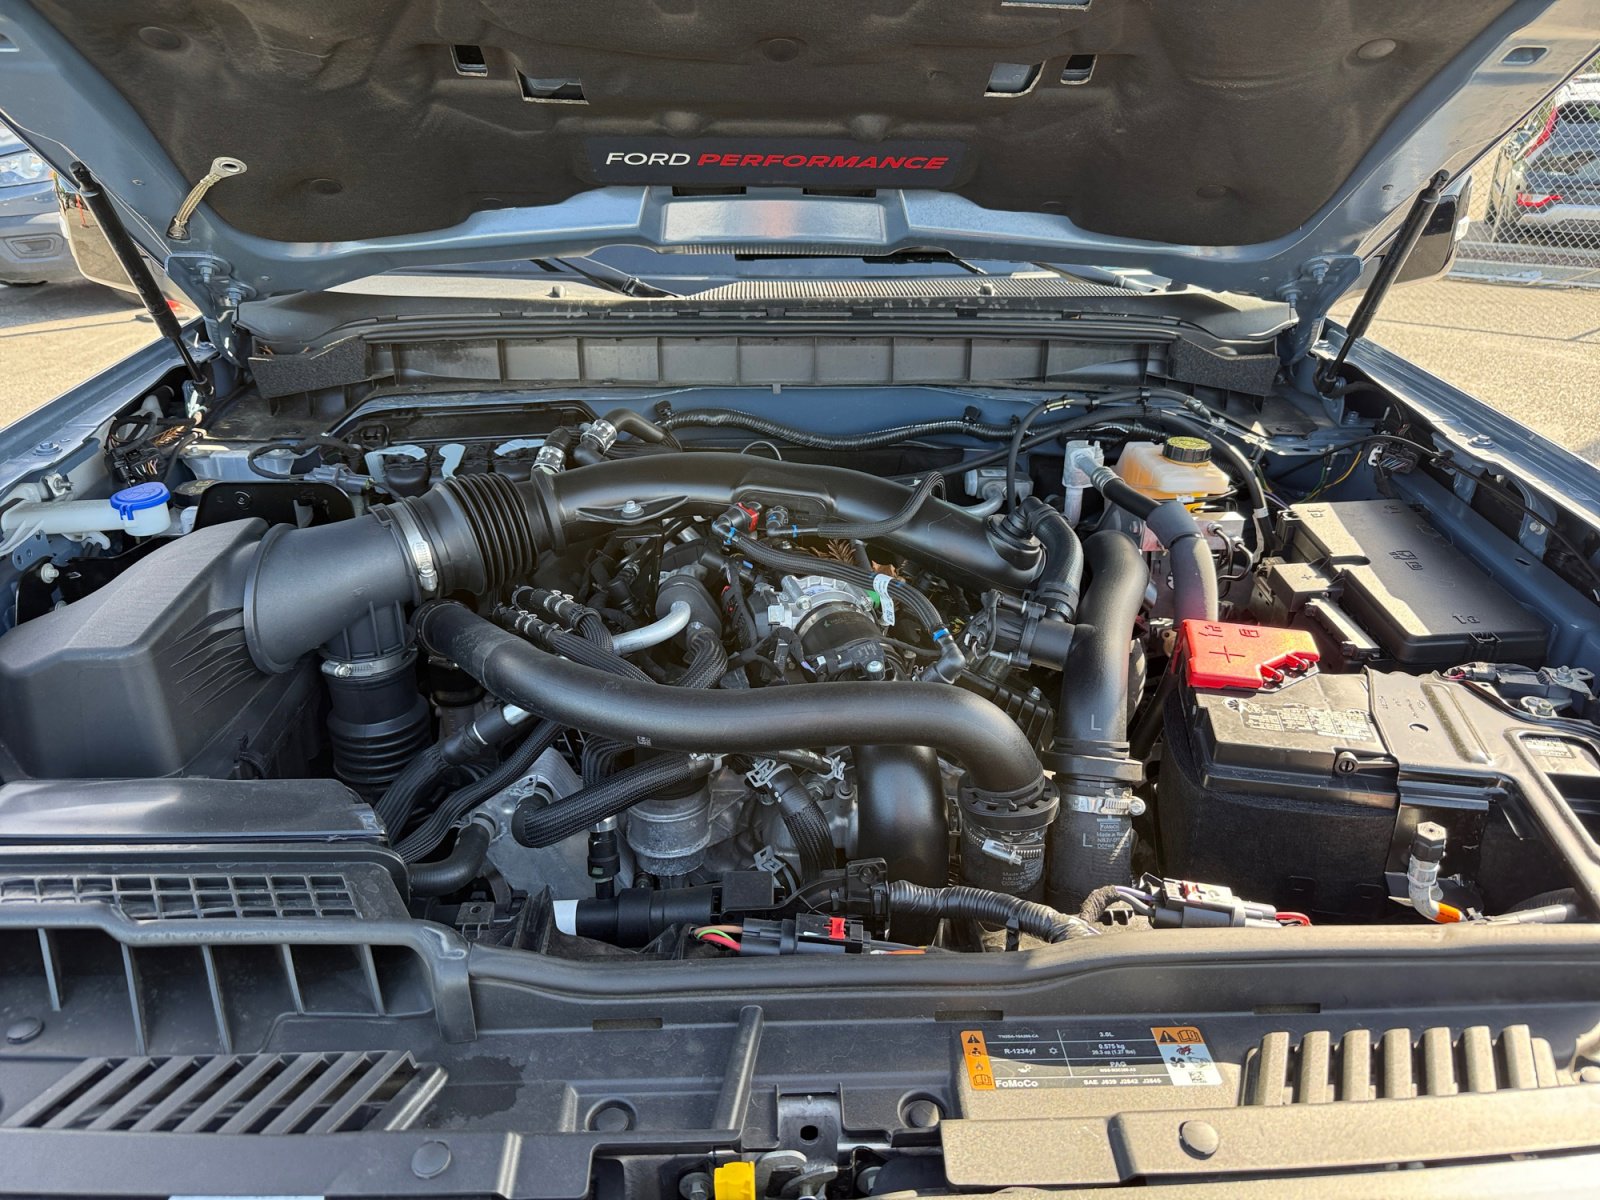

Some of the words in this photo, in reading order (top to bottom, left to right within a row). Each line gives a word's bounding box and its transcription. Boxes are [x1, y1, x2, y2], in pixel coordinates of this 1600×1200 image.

[605, 152, 691, 166] FORD
[697, 153, 949, 170] PERFORMANCE
[1116, 1043, 1126, 1051] kg
[995, 1079, 1039, 1088] FoMoCo
